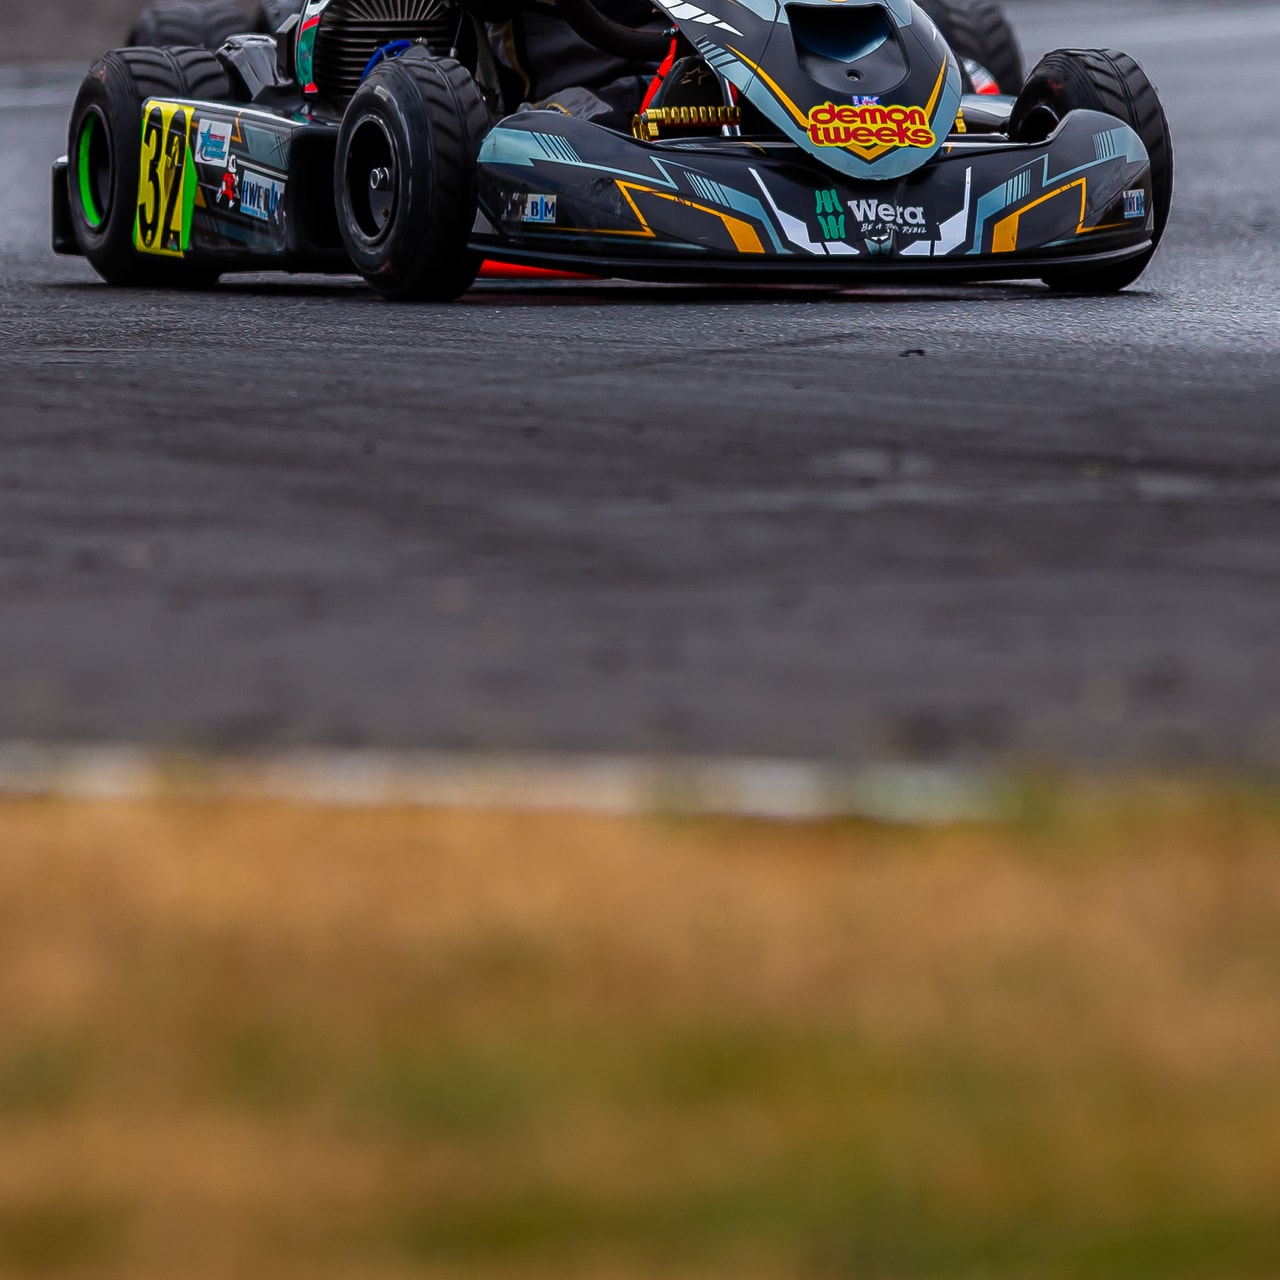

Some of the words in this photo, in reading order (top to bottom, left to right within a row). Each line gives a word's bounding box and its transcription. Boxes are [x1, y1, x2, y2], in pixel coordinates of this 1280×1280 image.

[811, 103, 926, 126] demon
[809, 122, 934, 145] tweeks
[138, 106, 187, 250] 32
[847, 199, 926, 225] Wera
